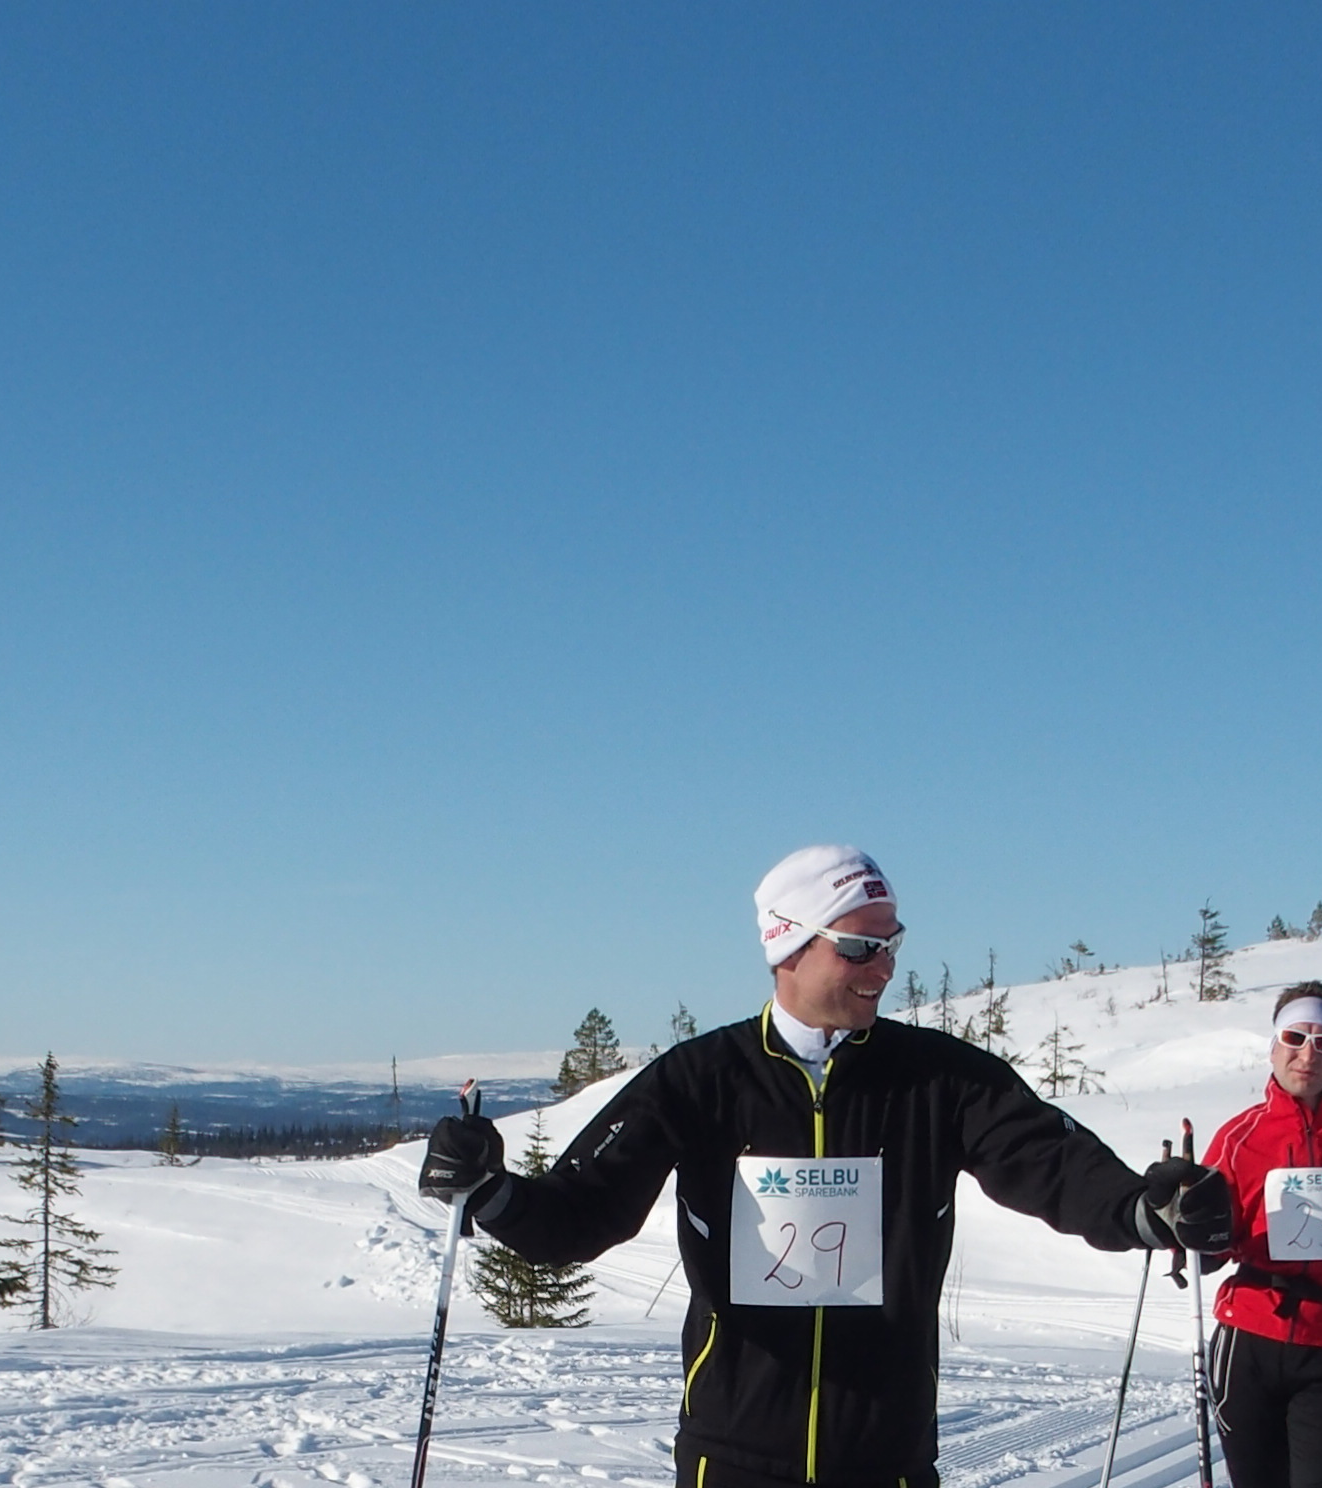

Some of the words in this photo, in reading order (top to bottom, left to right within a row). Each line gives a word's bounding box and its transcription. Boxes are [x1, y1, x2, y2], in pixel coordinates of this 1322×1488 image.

[795, 1168, 859, 1186] SELBU
[794, 1186, 859, 1198] SPAREBANK
[764, 1221, 847, 1290] 29
